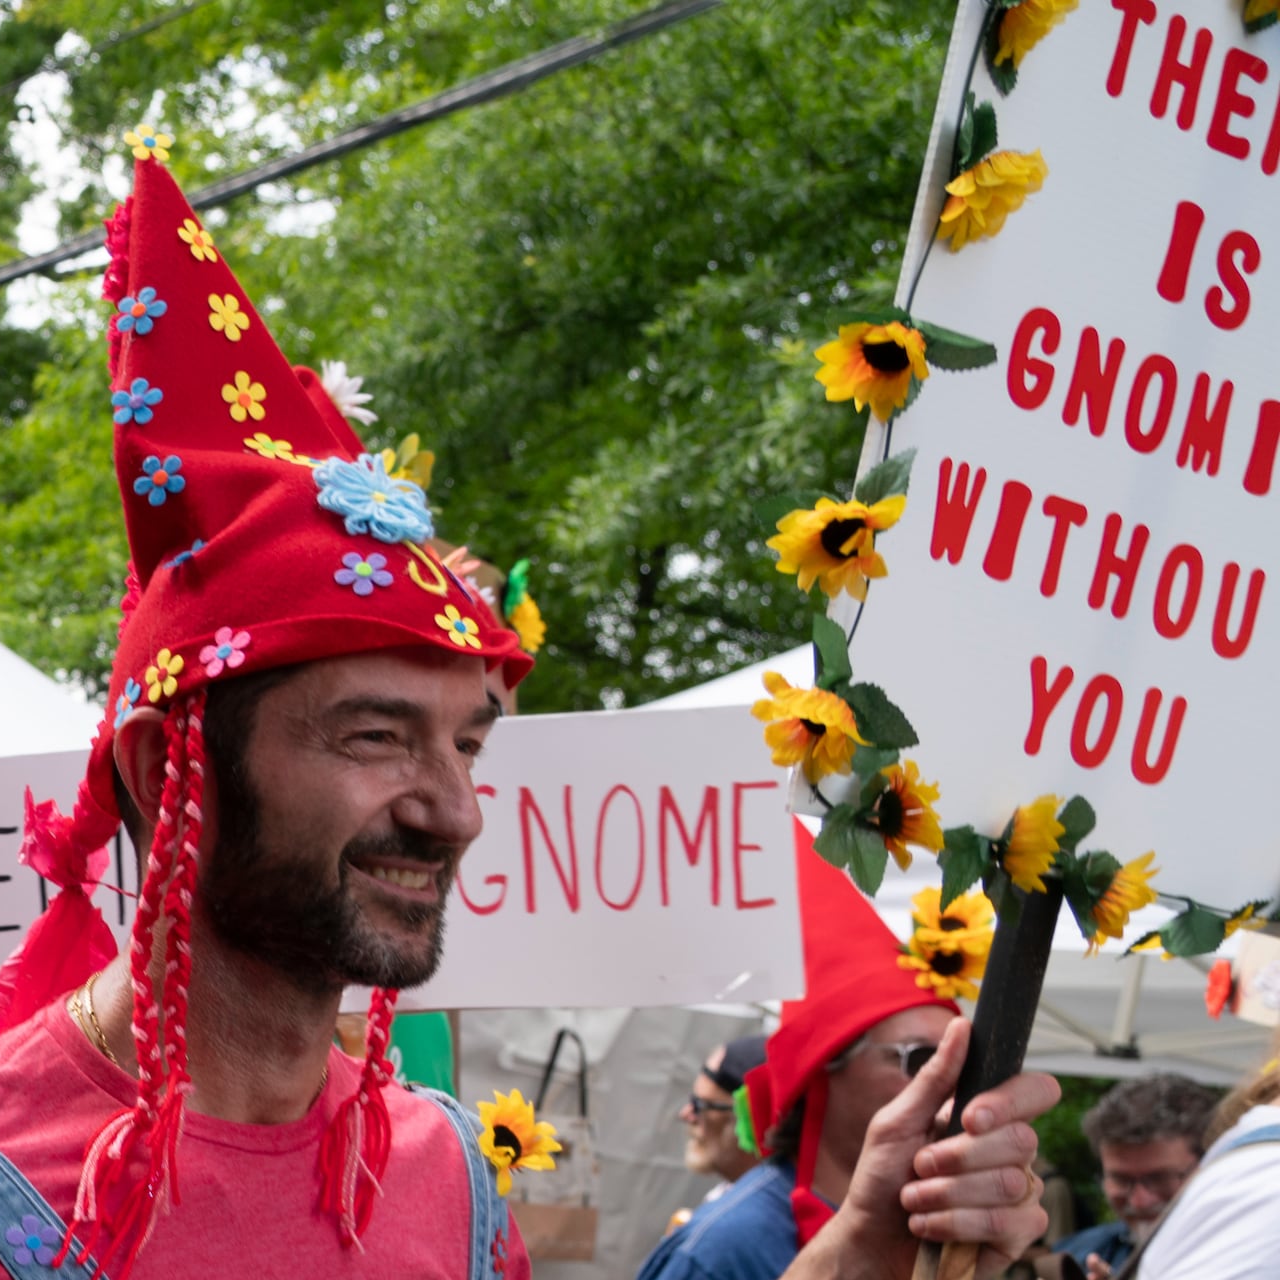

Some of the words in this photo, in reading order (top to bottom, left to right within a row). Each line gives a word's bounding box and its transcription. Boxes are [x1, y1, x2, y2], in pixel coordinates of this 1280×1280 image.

[1106, 0, 1280, 177] THE
[1156, 200, 1262, 331] IS
[1006, 306, 1280, 497] GNOMI
[929, 456, 1267, 660] WITHOU
[1023, 655, 1188, 786] YOU
[456, 781, 778, 916] GNOME
